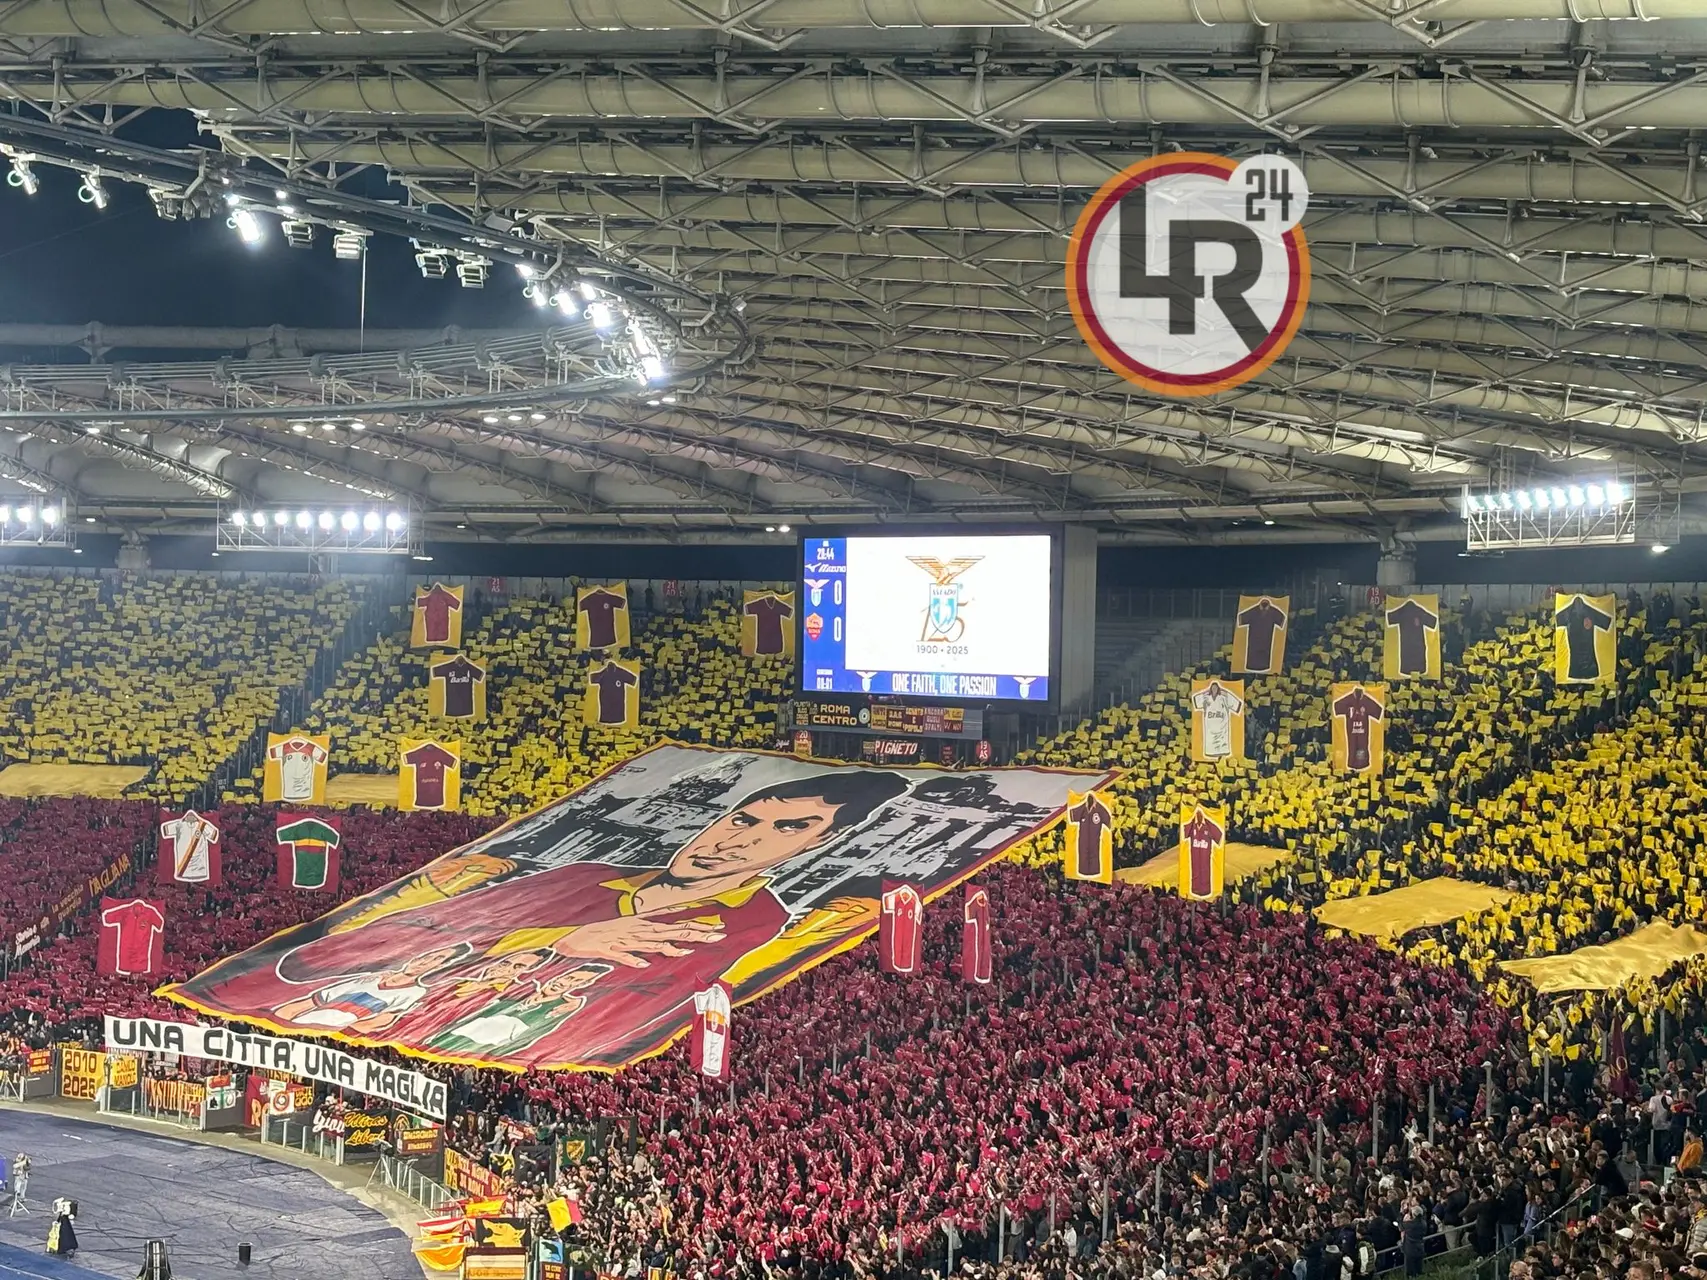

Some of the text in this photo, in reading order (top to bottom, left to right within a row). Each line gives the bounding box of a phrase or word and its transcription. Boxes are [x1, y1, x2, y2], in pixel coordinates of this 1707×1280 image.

[834, 580, 842, 605] 0
[834, 617, 842, 641] 0
[916, 645, 969, 655] 1900 2025
[892, 673, 996, 696] ONE FAITH, ONE PASSION
[820, 704, 851, 714] ROMA
[813, 715, 858, 725] CENTRO
[875, 740, 918, 755] PIGNETO
[979, 750, 988, 759] AS
[980, 741, 988, 749] 19
[64, 1050, 97, 1074] 2010
[113, 1020, 184, 1052] UNA
[305, 1046, 354, 1086] UNA
[365, 1061, 445, 1116] MAGLIA
[63, 1074, 96, 1099] 2025
